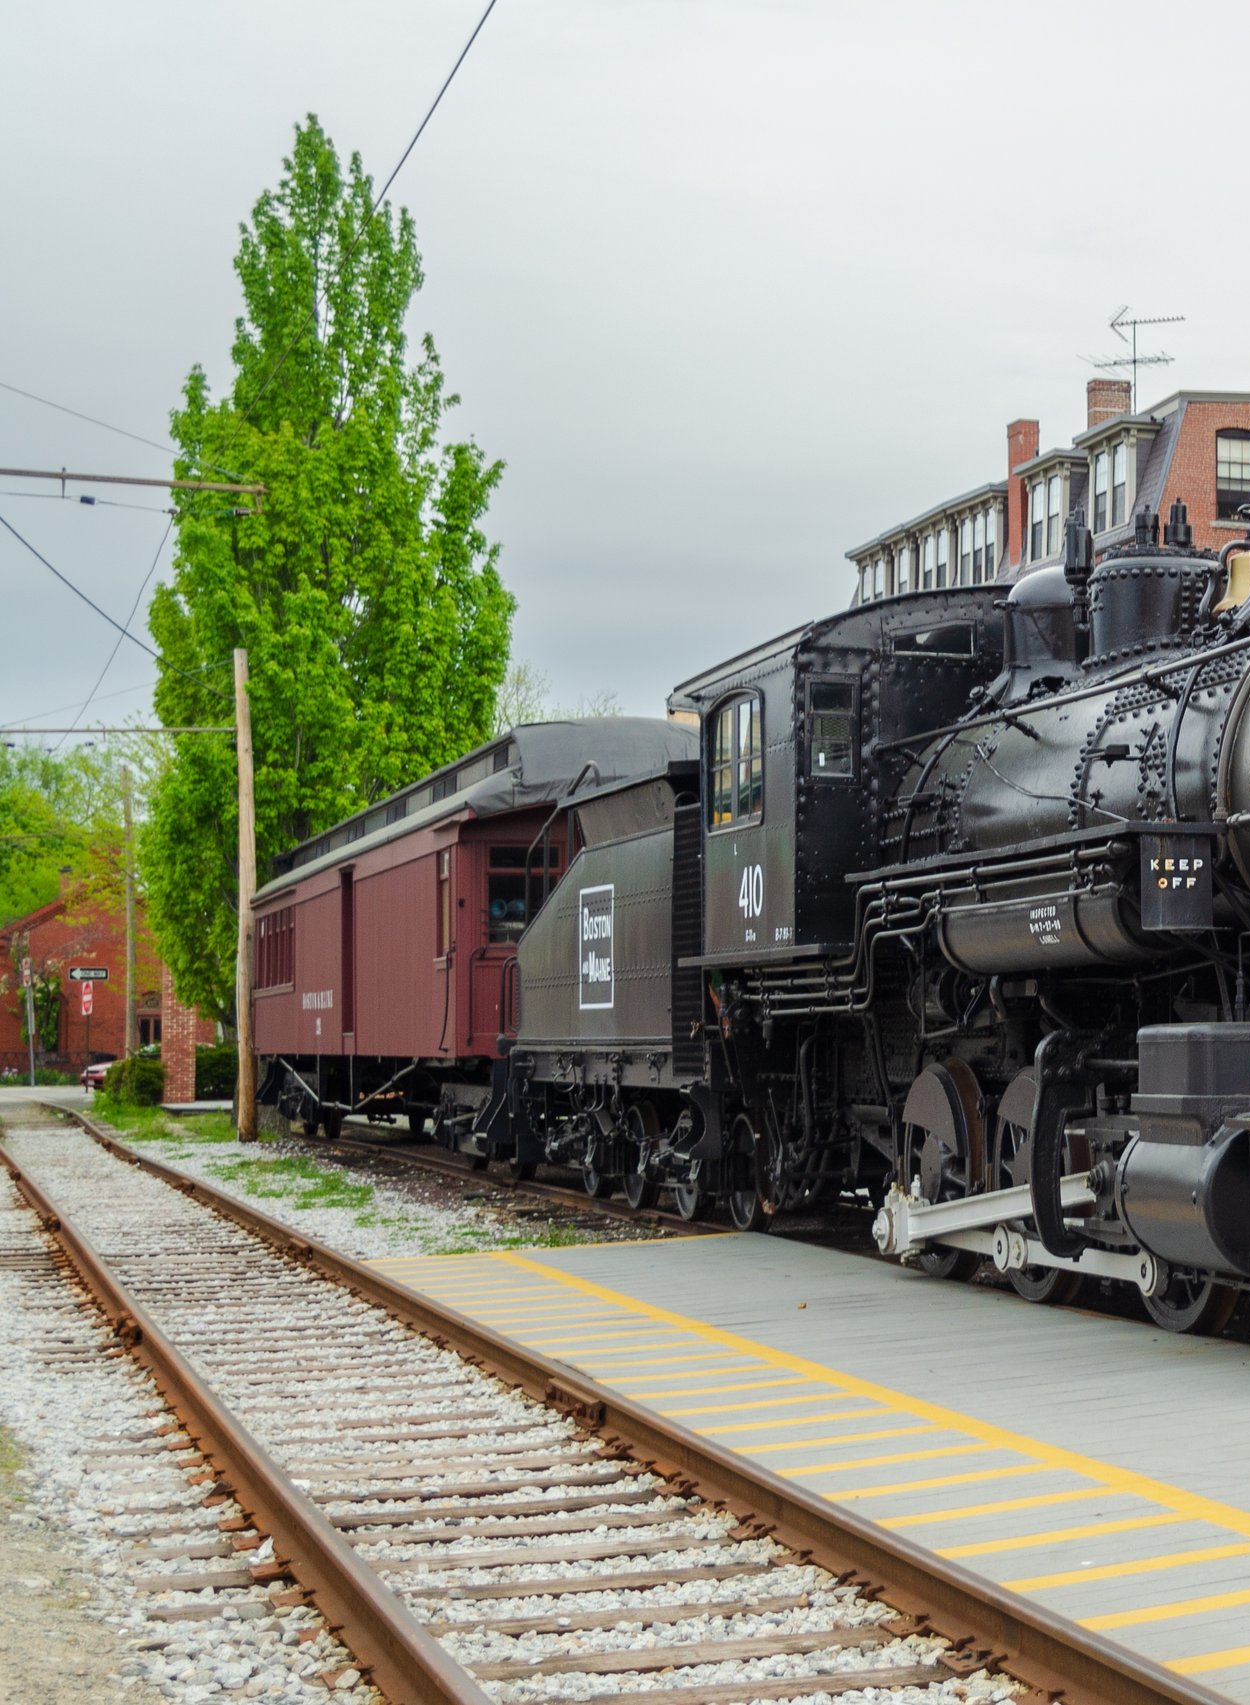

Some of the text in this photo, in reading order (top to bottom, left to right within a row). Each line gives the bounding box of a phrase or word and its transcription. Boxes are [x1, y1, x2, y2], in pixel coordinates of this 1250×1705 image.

[1150, 858, 1204, 871] KEEP
[738, 864, 763, 919] 410
[1158, 876, 1197, 890] OFF
[1030, 906, 1056, 919] INSPECTED
[583, 907, 611, 941] BOSTON
[589, 951, 610, 982] MAINE
